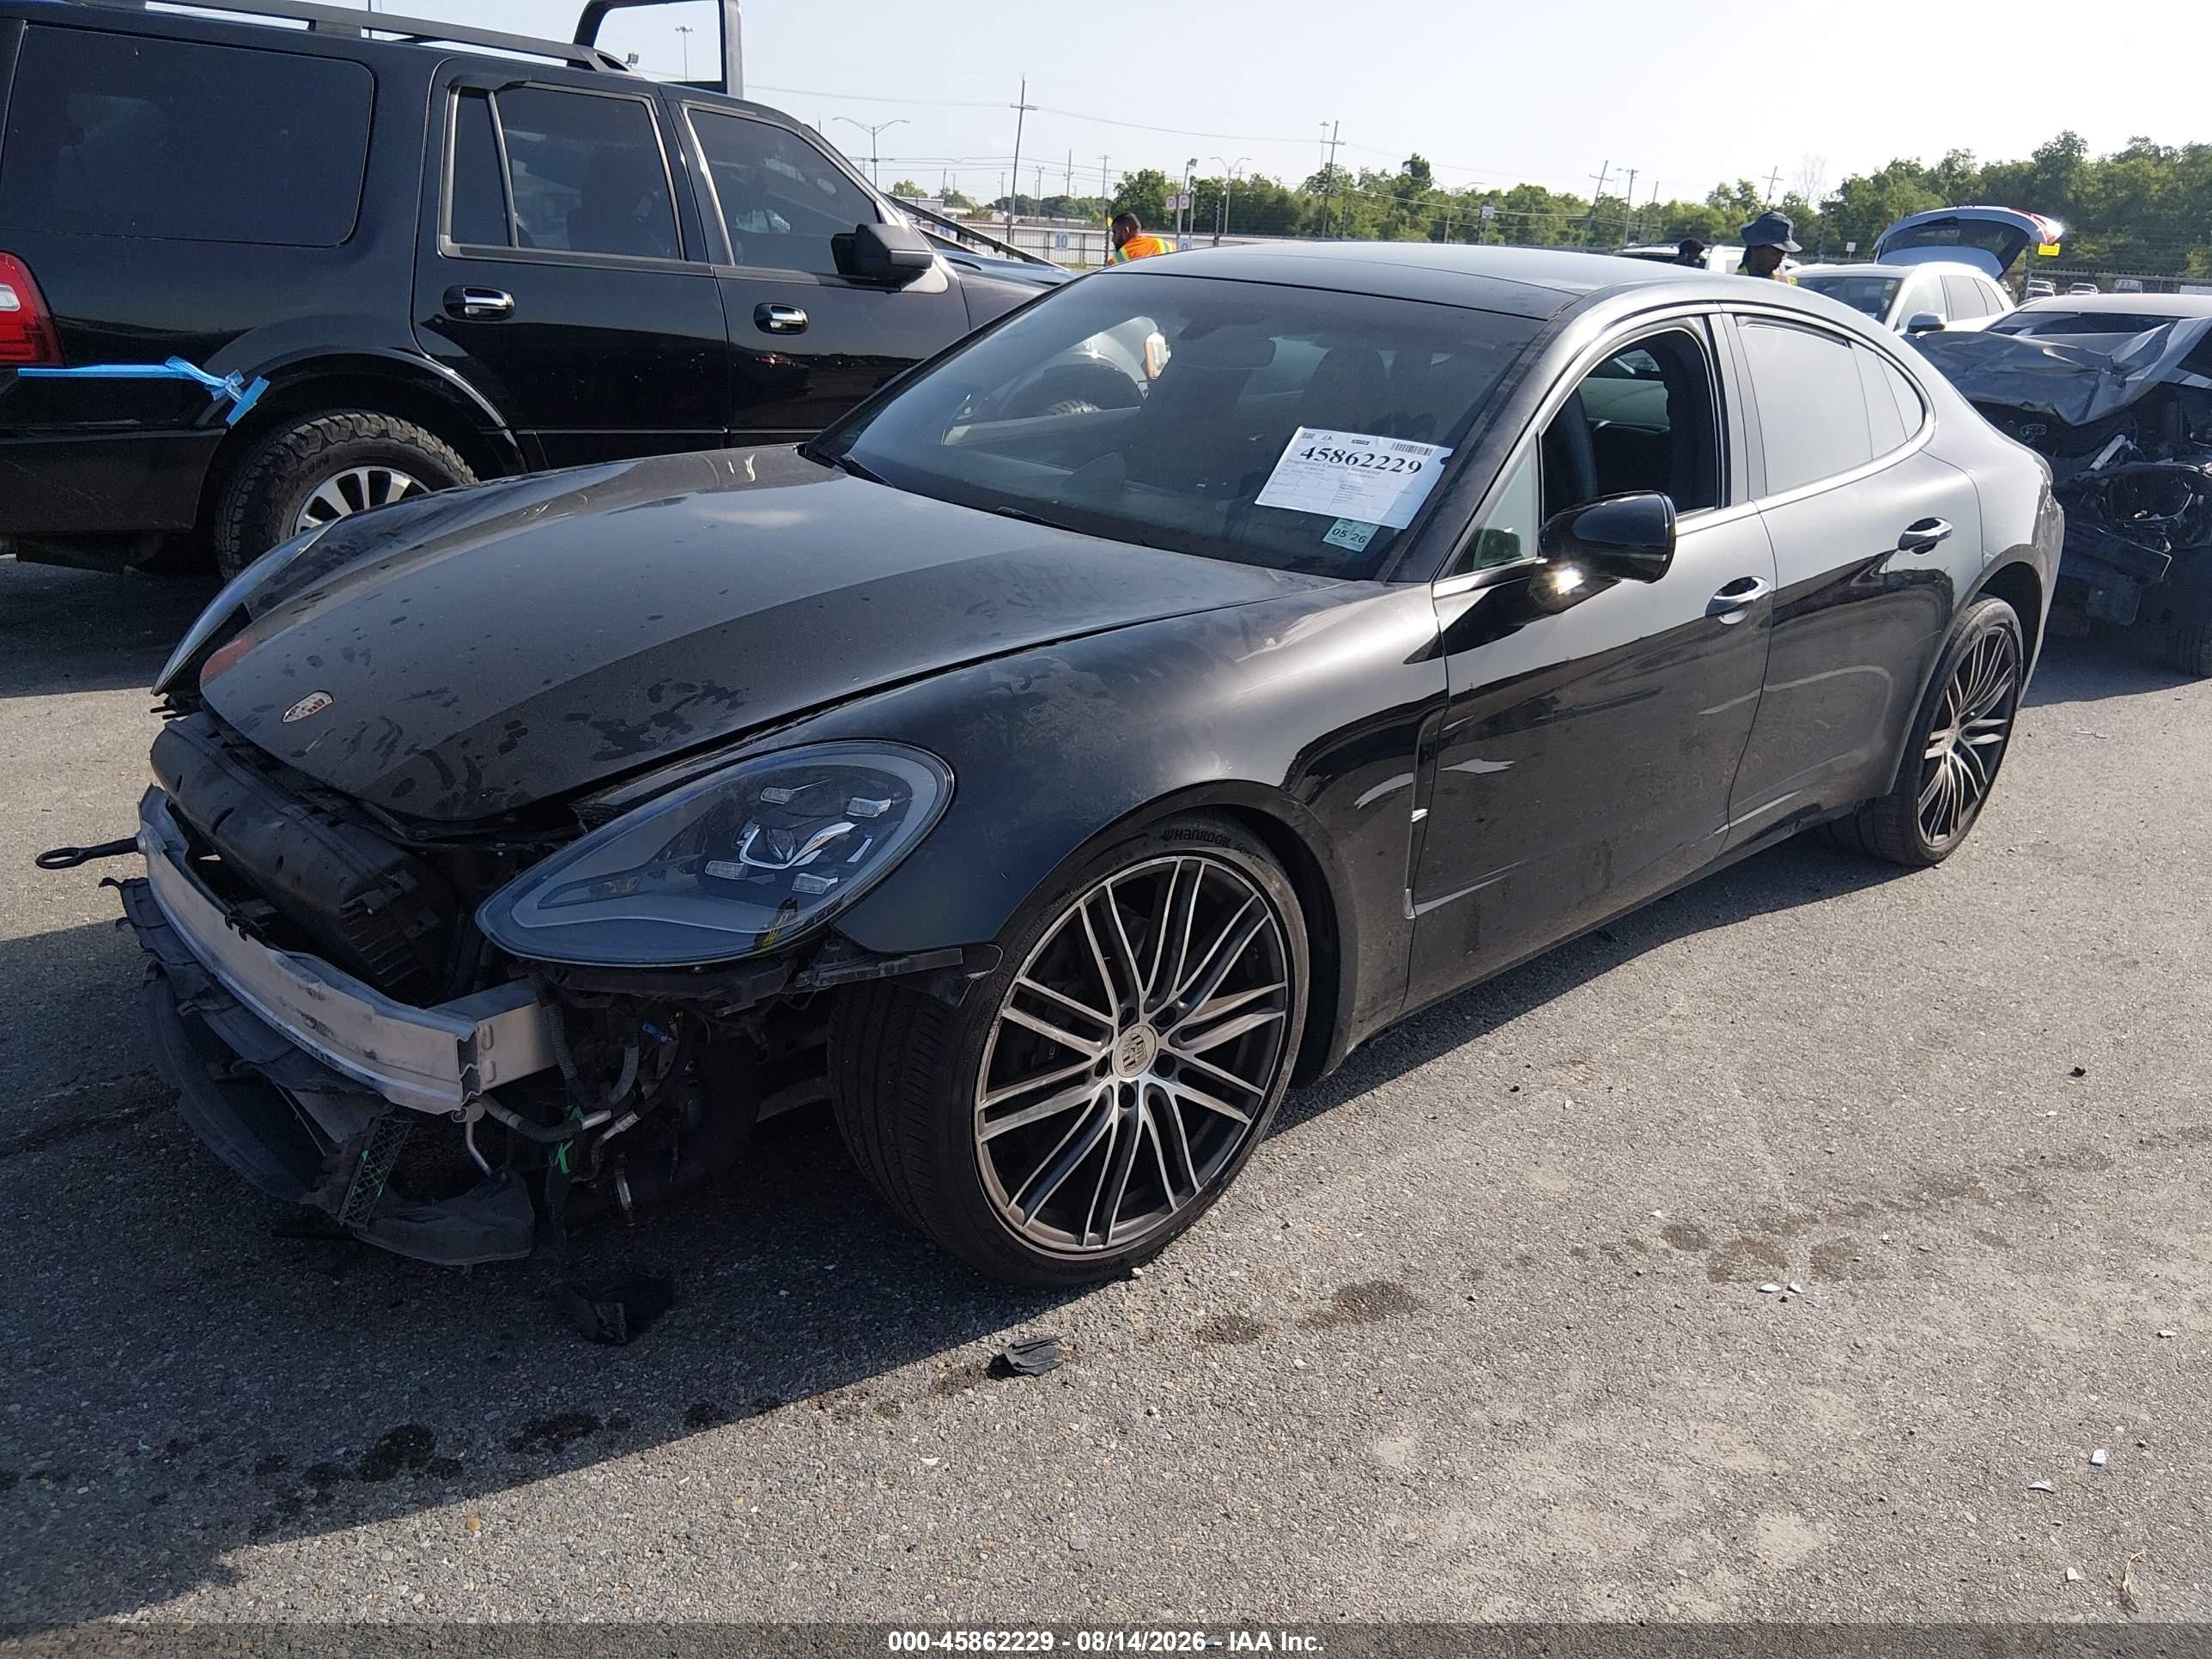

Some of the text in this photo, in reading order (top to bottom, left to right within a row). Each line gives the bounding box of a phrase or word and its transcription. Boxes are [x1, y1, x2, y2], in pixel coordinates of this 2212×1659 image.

[1054, 234, 1068, 248] 10
[1299, 446, 1423, 475] 45862229
[1332, 528, 1367, 544] 05 26
